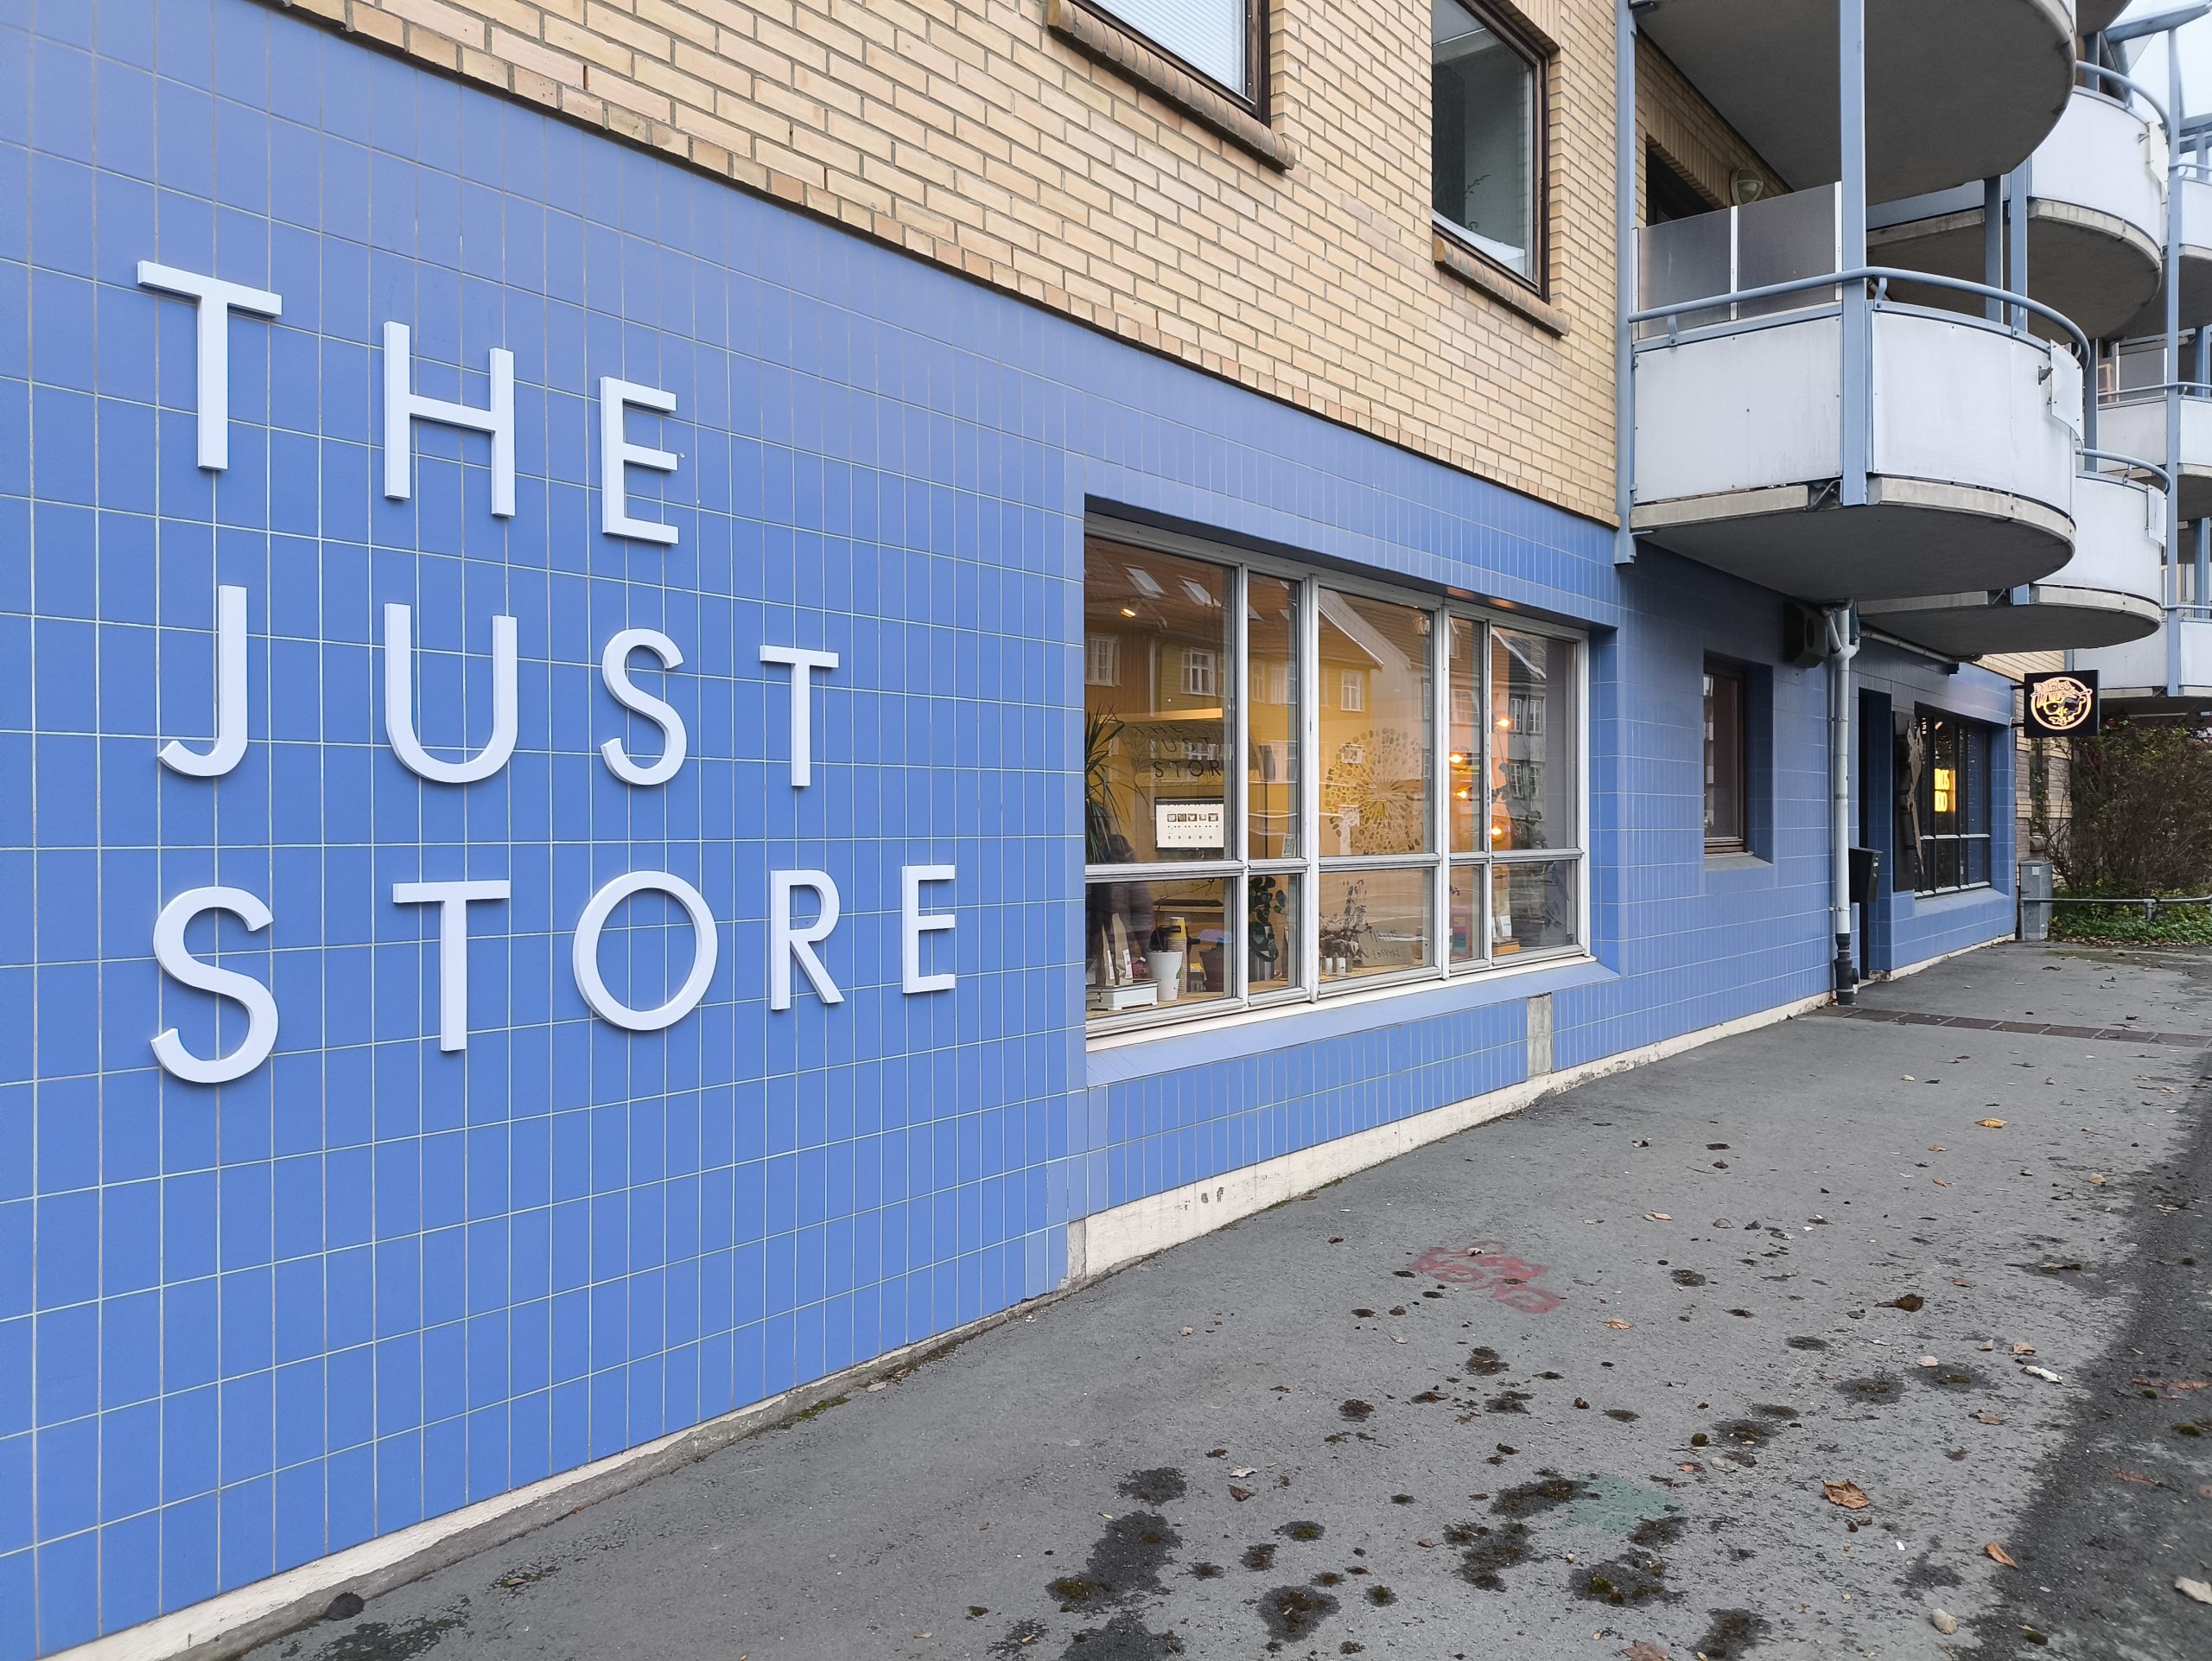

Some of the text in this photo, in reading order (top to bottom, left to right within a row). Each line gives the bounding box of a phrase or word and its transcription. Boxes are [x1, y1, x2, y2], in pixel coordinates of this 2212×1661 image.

[137, 260, 680, 545] THE
[157, 585, 840, 786] JUST
[1132, 724, 1185, 735] THE
[1153, 760, 1222, 778] STOR
[150, 864, 957, 1084] STORE
